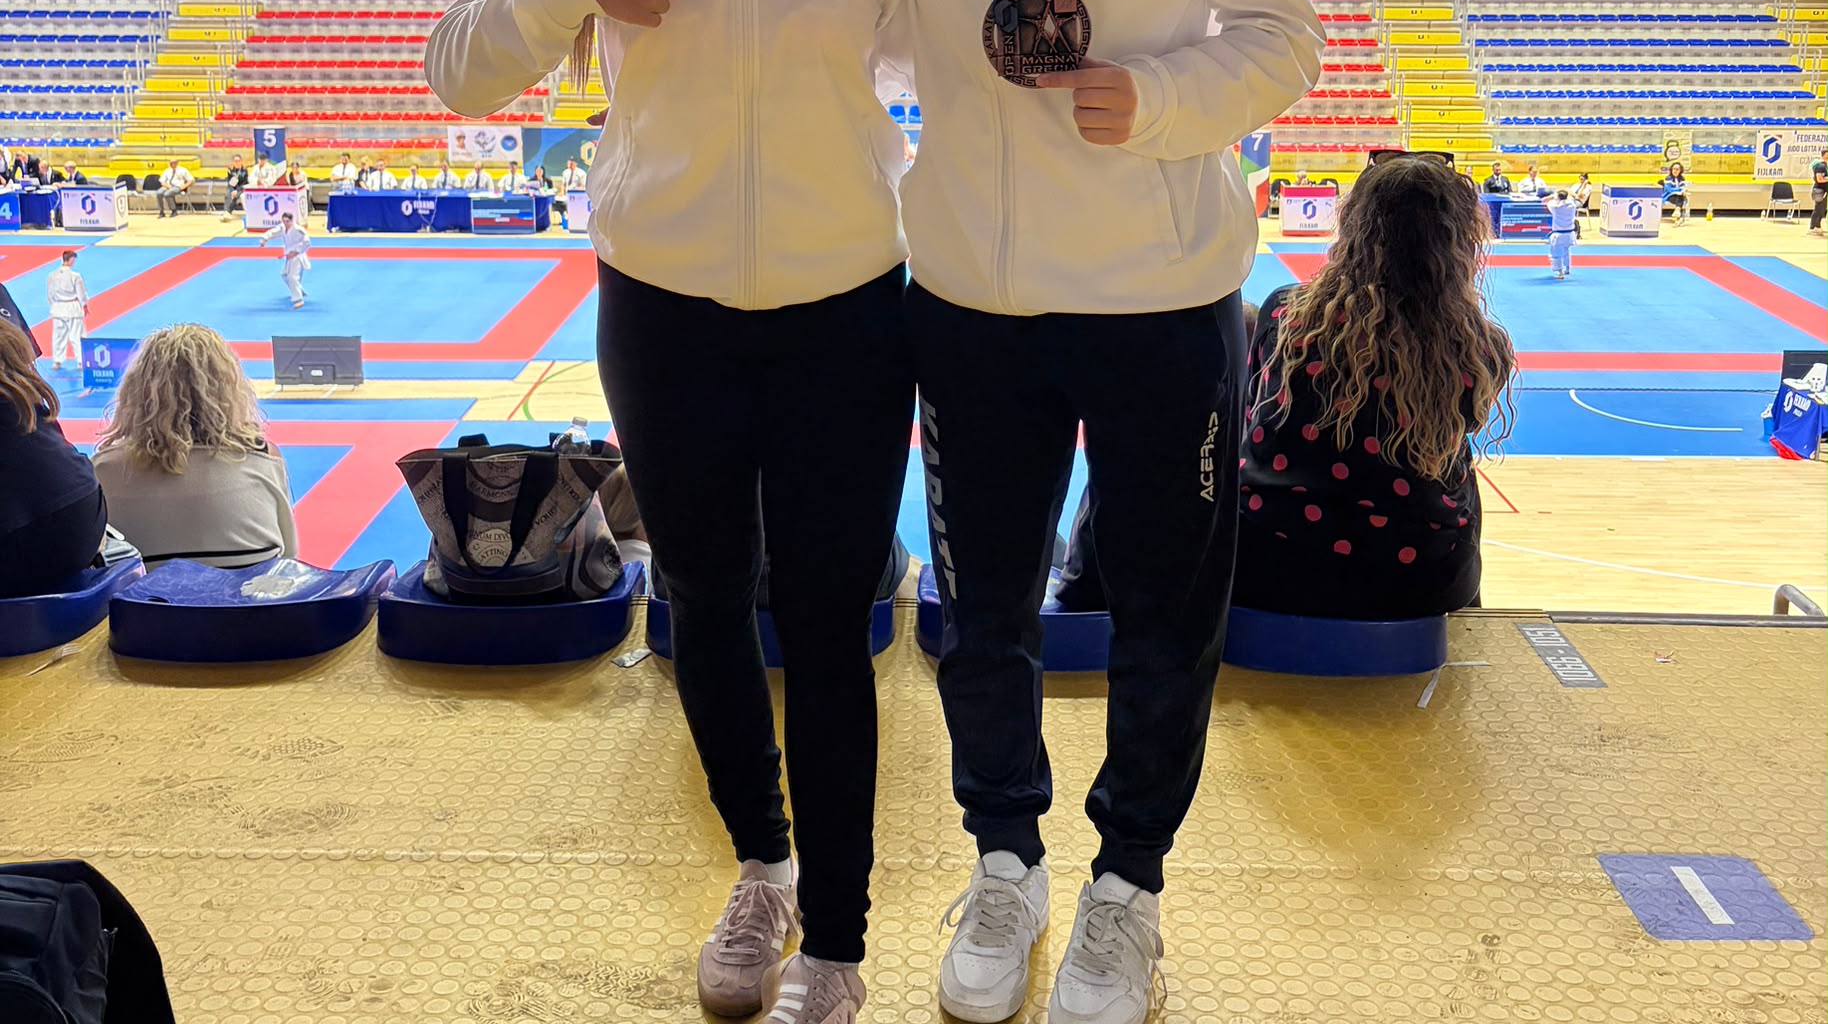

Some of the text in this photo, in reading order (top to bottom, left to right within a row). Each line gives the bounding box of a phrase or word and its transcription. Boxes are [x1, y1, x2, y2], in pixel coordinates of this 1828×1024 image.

[1004, 35, 1015, 76] OPEN
[1022, 55, 1076, 65] MAGNA
[263, 129, 277, 147] 5
[1251, 133, 1264, 151] 7
[1757, 168, 1783, 176] FIJLKAM
[0, 202, 12, 220] 4
[1523, 627, 1569, 646] 1051
[1545, 656, 1598, 681] 1066
